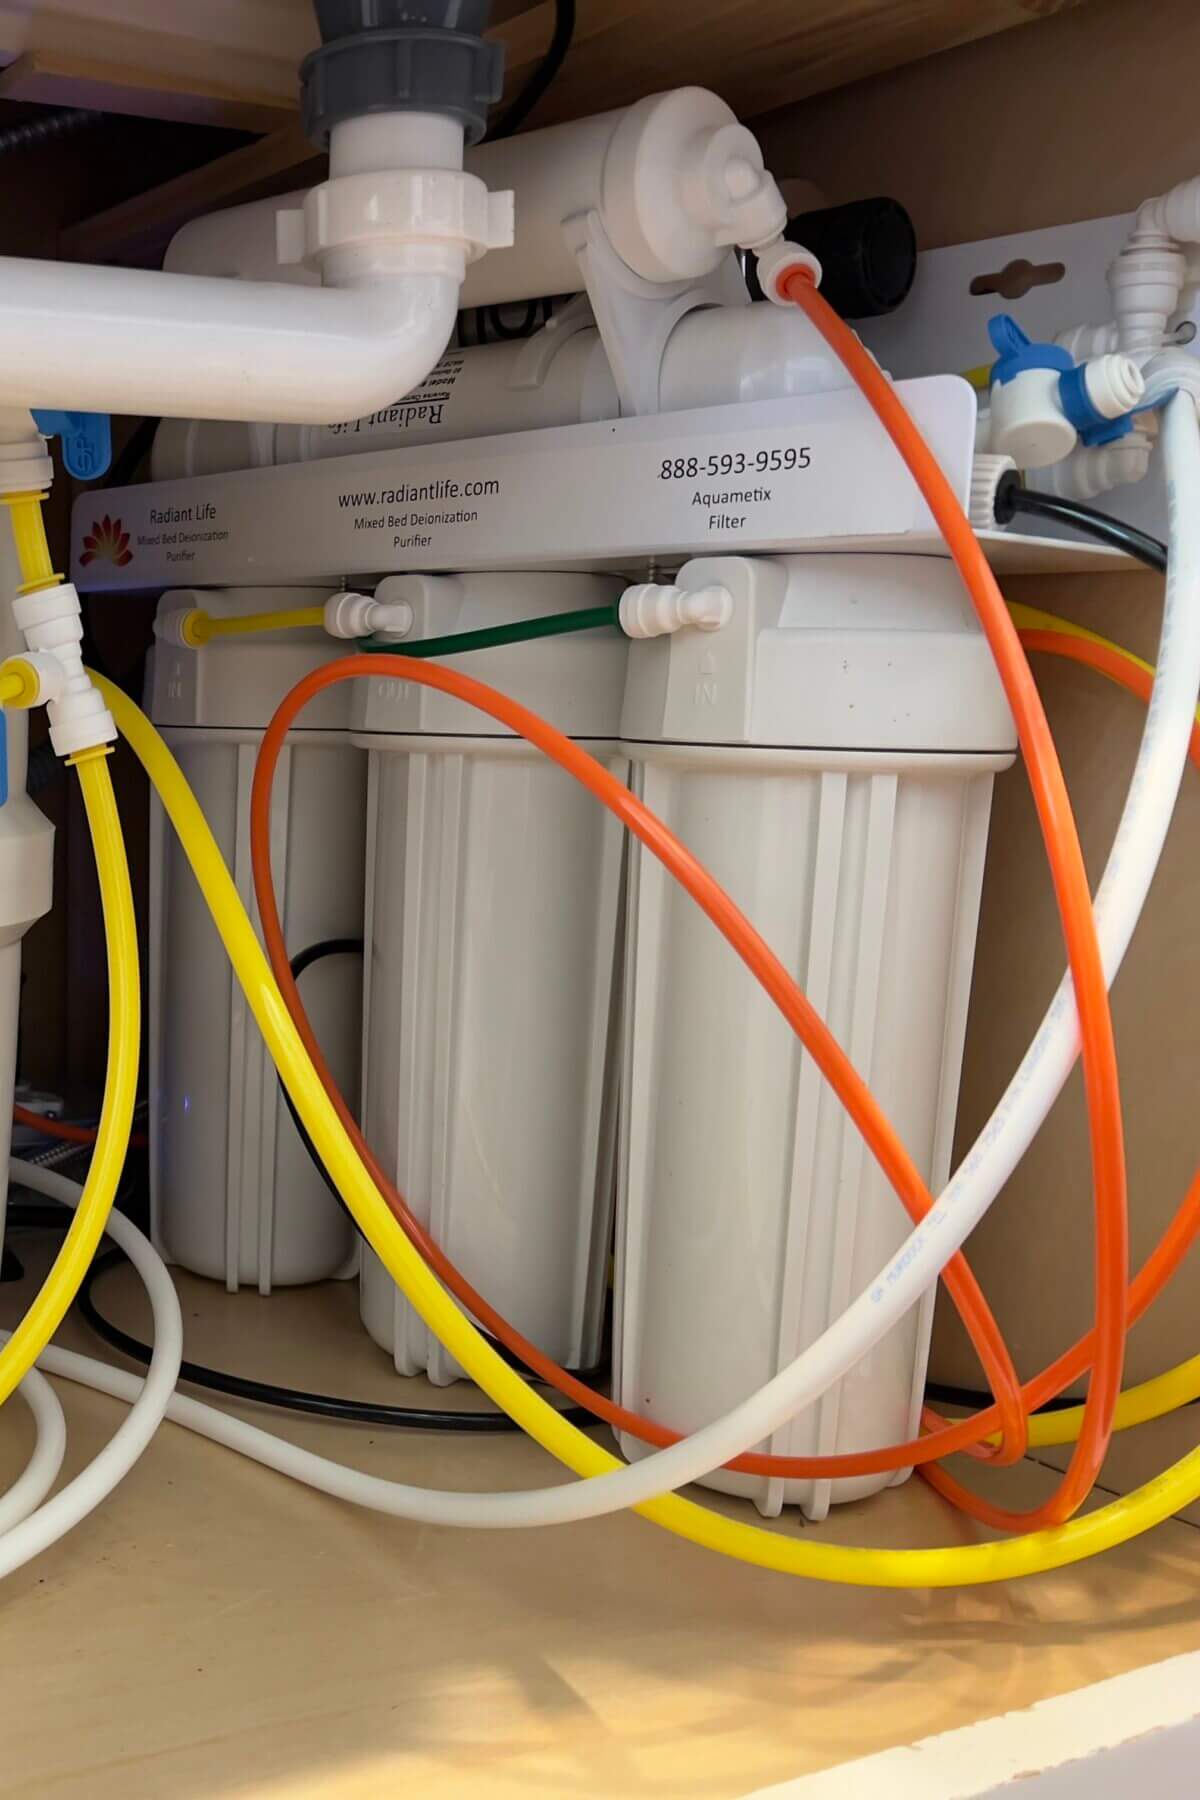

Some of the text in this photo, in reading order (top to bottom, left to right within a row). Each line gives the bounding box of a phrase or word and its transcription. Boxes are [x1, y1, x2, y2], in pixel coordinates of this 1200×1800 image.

[660, 447, 812, 480] 888-593-9595
[338, 479, 500, 508] www.radiantlife.com
[691, 487, 772, 509] Aquametix
[150, 503, 217, 524] Radiant Life
[353, 509, 478, 530] Mixed Bed Deionization
[708, 513, 747, 530] Filter
[393, 533, 432, 549] Purifier
[166, 549, 196, 562] Purifier
